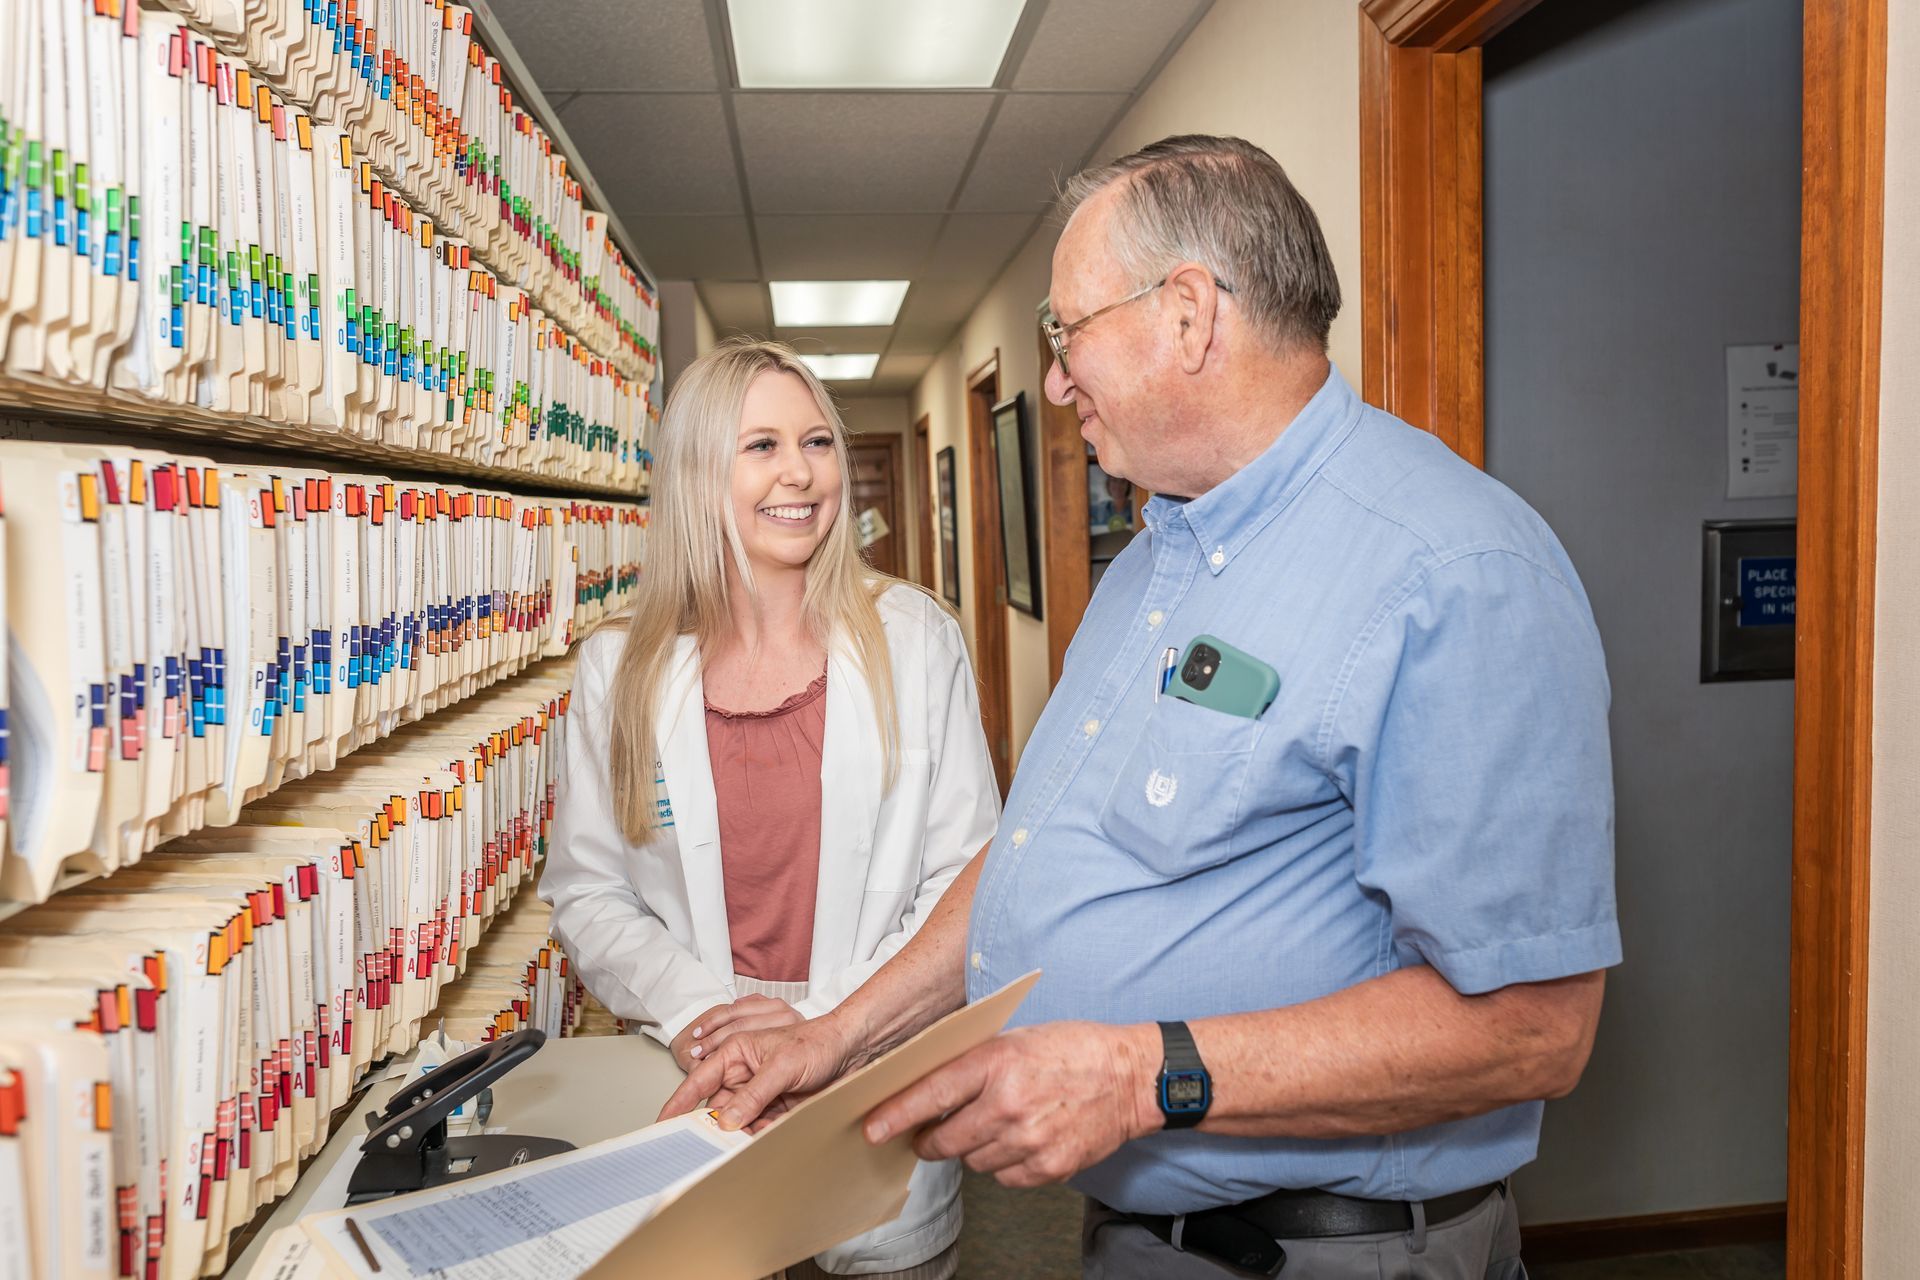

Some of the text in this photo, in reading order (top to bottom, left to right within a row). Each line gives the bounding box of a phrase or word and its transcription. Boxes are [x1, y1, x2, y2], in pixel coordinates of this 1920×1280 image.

[457, 17, 463, 29] 3
[288, 122, 296, 140] 2
[333, 143, 339, 160] 2
[352, 167, 358, 184] 2
[436, 246, 442, 259] 9
[299, 280, 307, 298] M
[337, 294, 344, 312] M
[301, 315, 310, 332] O
[338, 328, 344, 345] O
[251, 500, 259, 518] 3
[337, 493, 342, 509] 3
[1748, 568, 1788, 582] PLACE
[420, 610, 426, 624] P
[1762, 603, 1776, 615] IN
[396, 622, 401, 636] P
[342, 633, 348, 649] P
[420, 636, 425, 649] R
[153, 666, 161, 688] P
[256, 671, 264, 689] P
[339, 666, 345, 682] O
[76, 694, 86, 718] P
[252, 708, 260, 727] O
[469, 765, 473, 776] 2
[413, 797, 418, 811] 3
[362, 826, 368, 840] 2
[332, 855, 338, 872] 3
[288, 875, 295, 894] 1
[468, 873, 474, 886] S
[466, 897, 471, 909] C
[444, 922, 450, 935] S
[410, 930, 416, 945] S
[196, 944, 205, 965] 2
[441, 947, 447, 960] C
[357, 959, 364, 974] S
[408, 958, 415, 972] A
[334, 995, 343, 1012] S
[357, 988, 365, 1002] A
[332, 1030, 341, 1047] A
[294, 1039, 301, 1056] S
[251, 1067, 258, 1086] S
[294, 1072, 303, 1090] A
[189, 1143, 198, 1164] S
[183, 1184, 193, 1206] A
